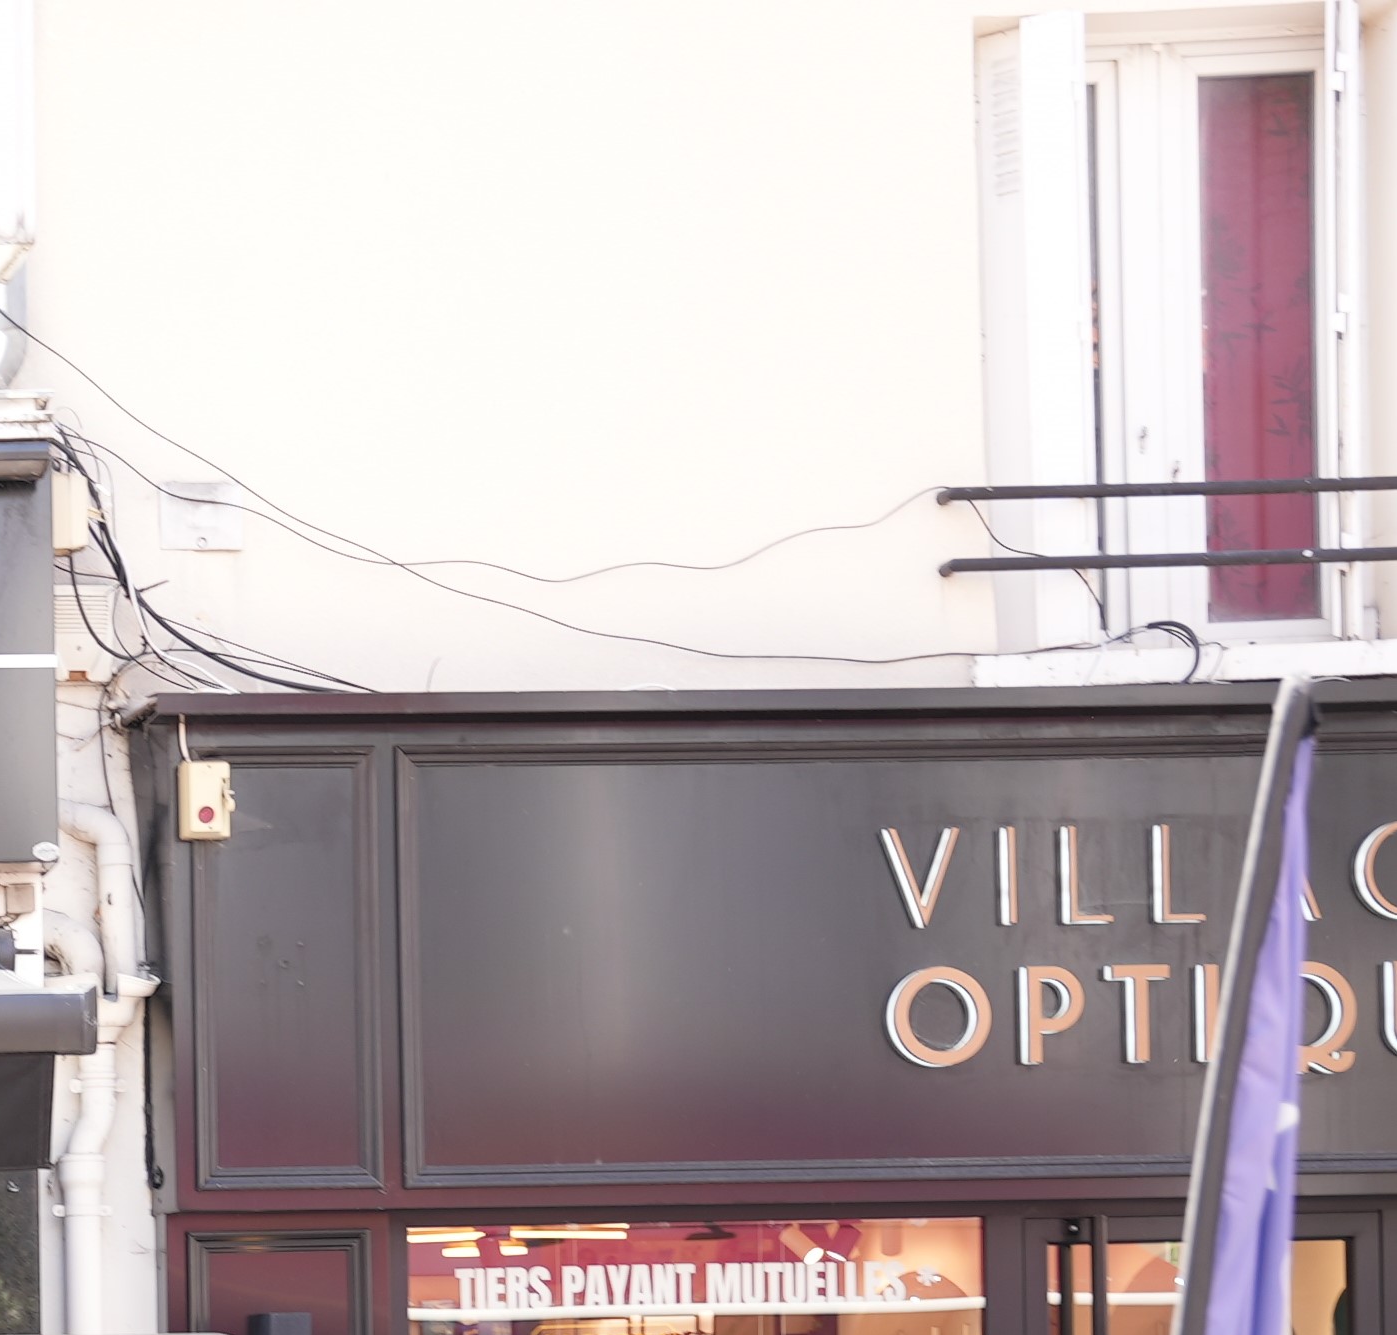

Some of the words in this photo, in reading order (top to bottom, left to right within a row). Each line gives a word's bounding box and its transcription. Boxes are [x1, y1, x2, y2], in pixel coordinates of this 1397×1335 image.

[454, 1264, 552, 1310] TIERS
[561, 1262, 697, 1308] PAYANT
[706, 1260, 907, 1304] MUTUELLES
